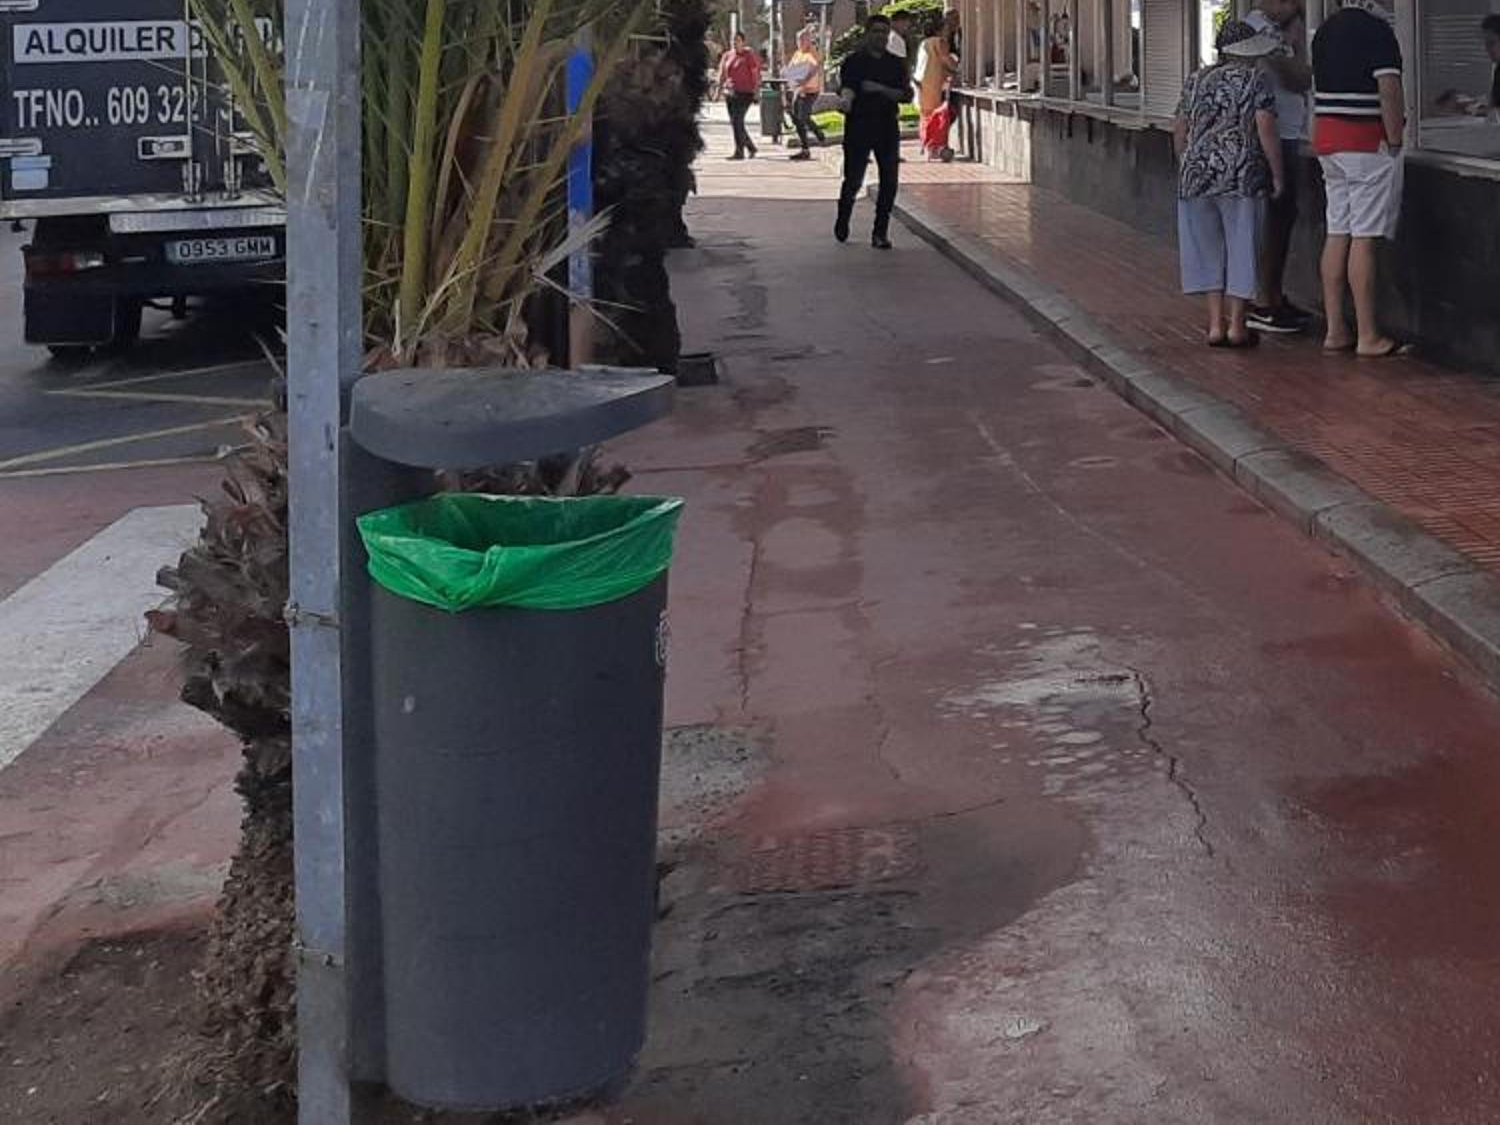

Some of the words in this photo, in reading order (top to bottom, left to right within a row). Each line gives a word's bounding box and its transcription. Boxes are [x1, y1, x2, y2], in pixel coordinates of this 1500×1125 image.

[25, 25, 176, 55] ALQUILER
[107, 86, 150, 125] 609
[180, 240, 229, 258] 0953
